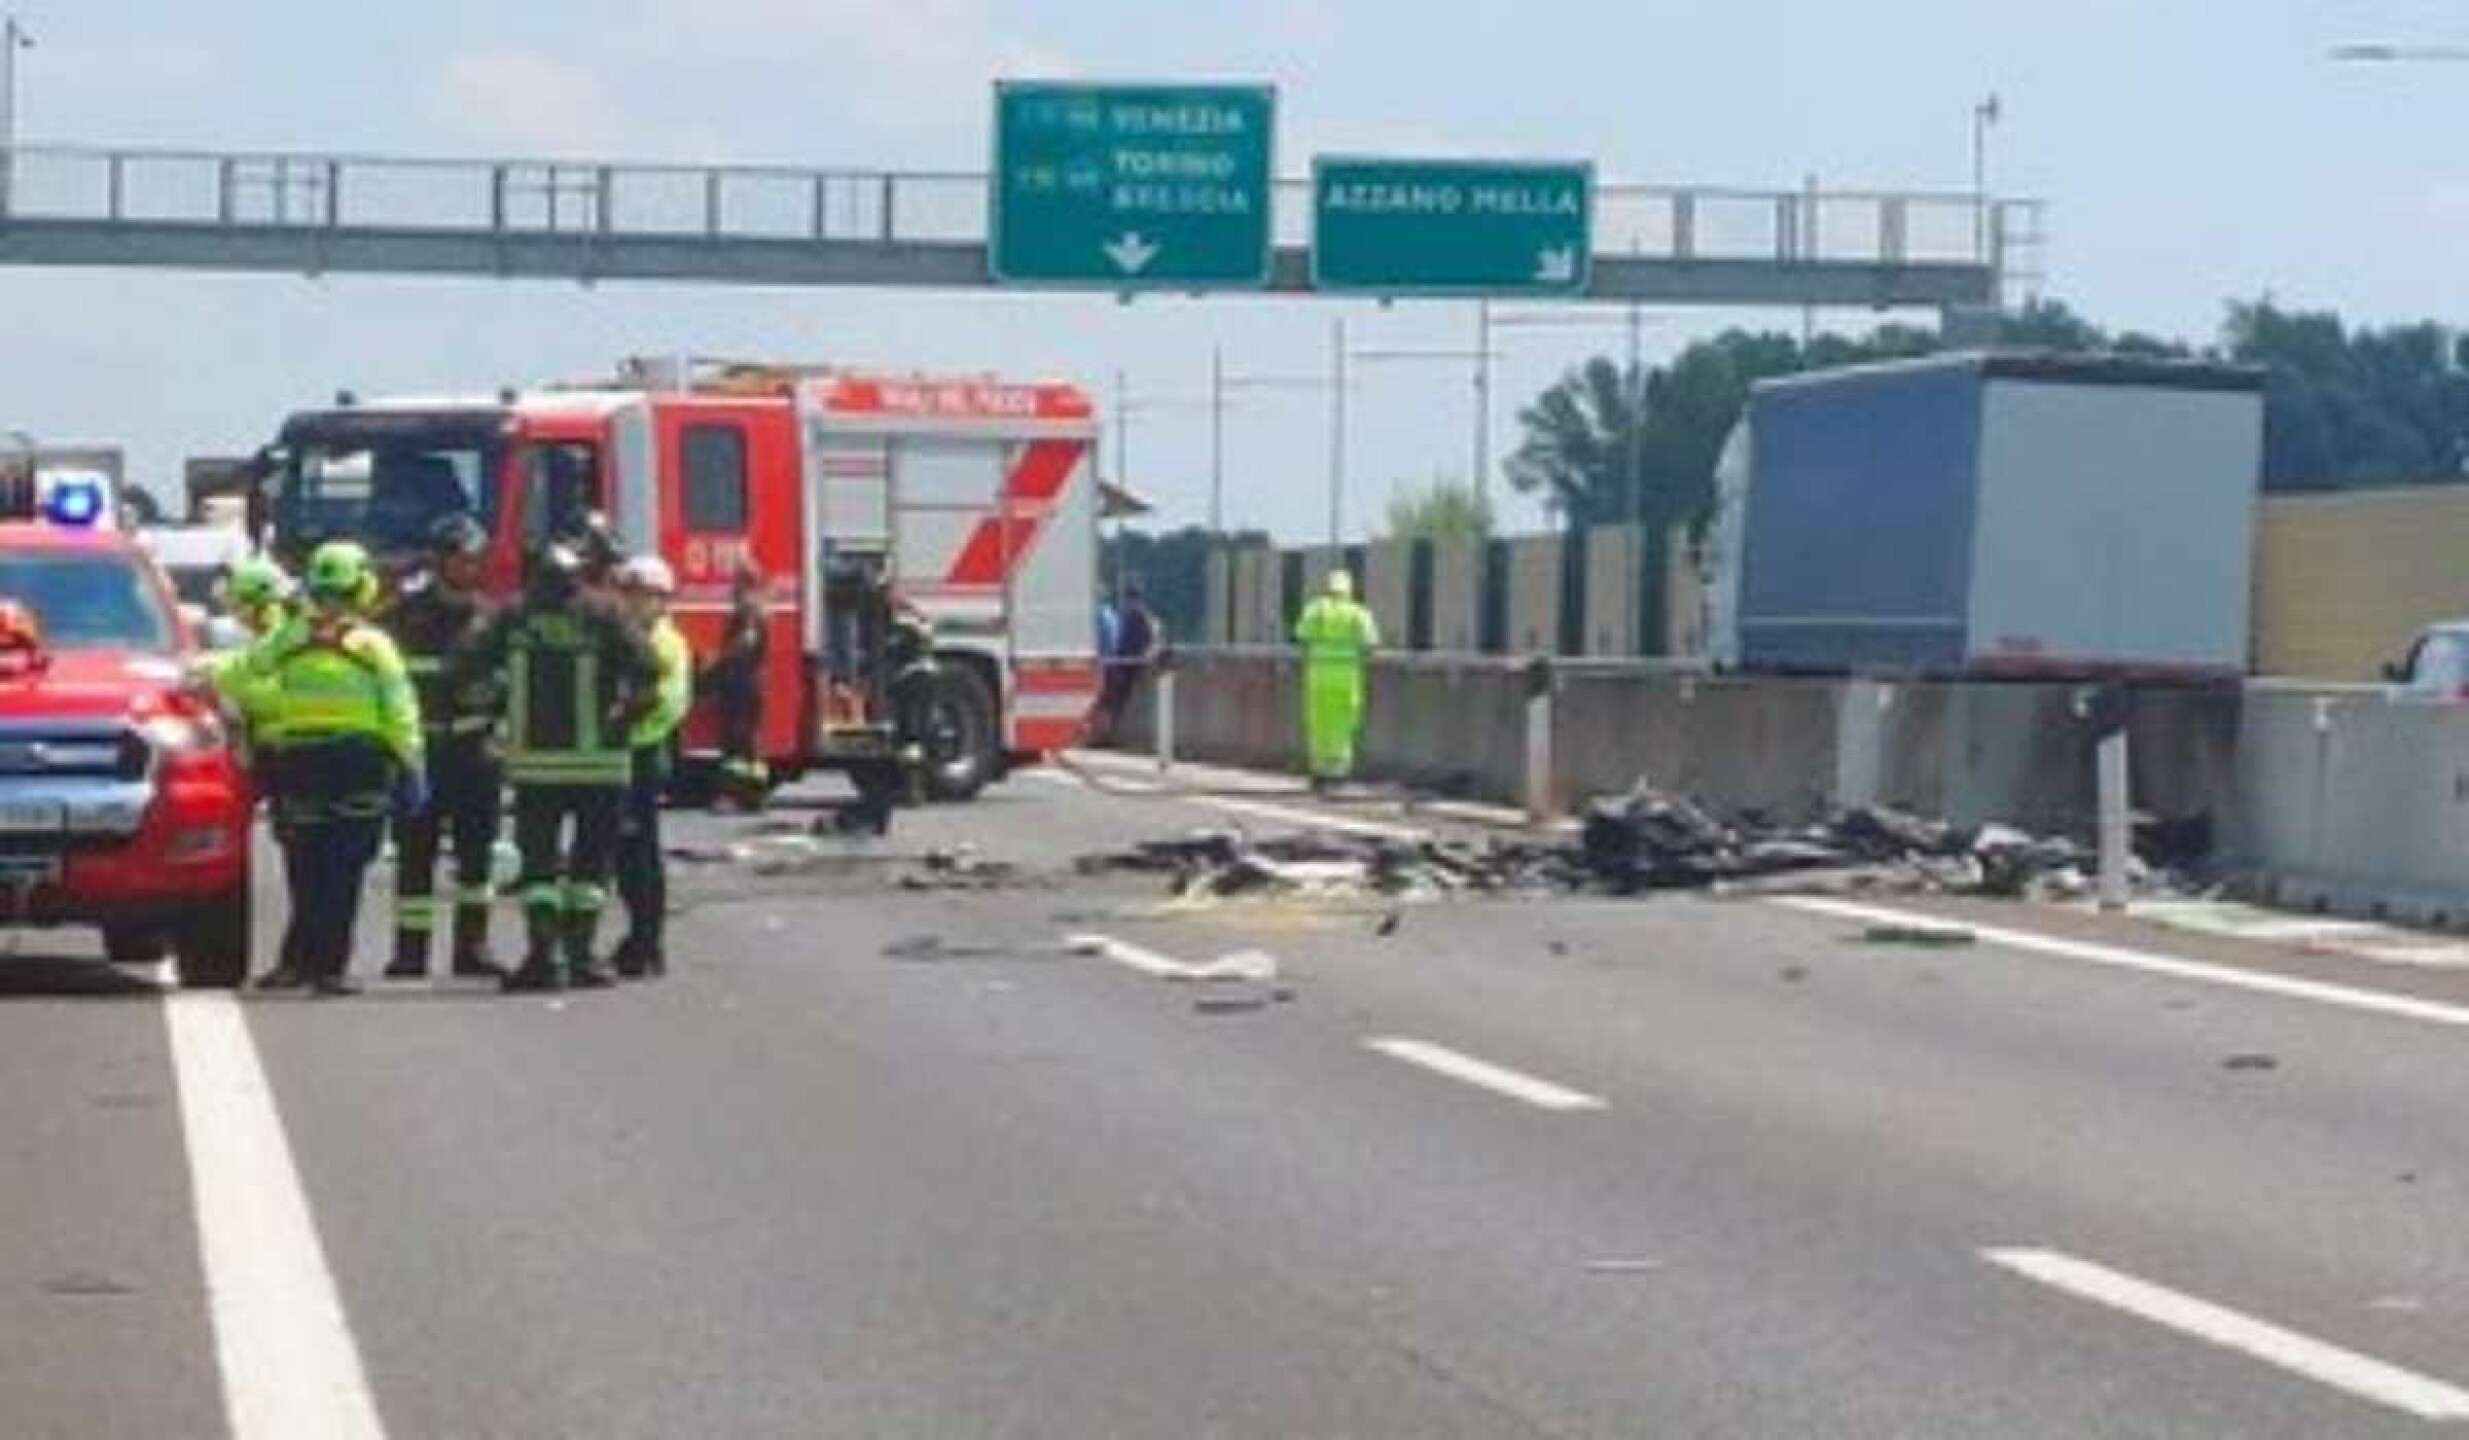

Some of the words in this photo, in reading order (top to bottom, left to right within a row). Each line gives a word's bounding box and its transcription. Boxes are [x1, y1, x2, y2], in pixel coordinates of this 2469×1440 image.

[1111, 105, 1246, 135] VENEZIA
[1111, 150, 1236, 177] TORINO
[1324, 182, 1461, 214] AZZANO
[1471, 188, 1579, 216] MELLA
